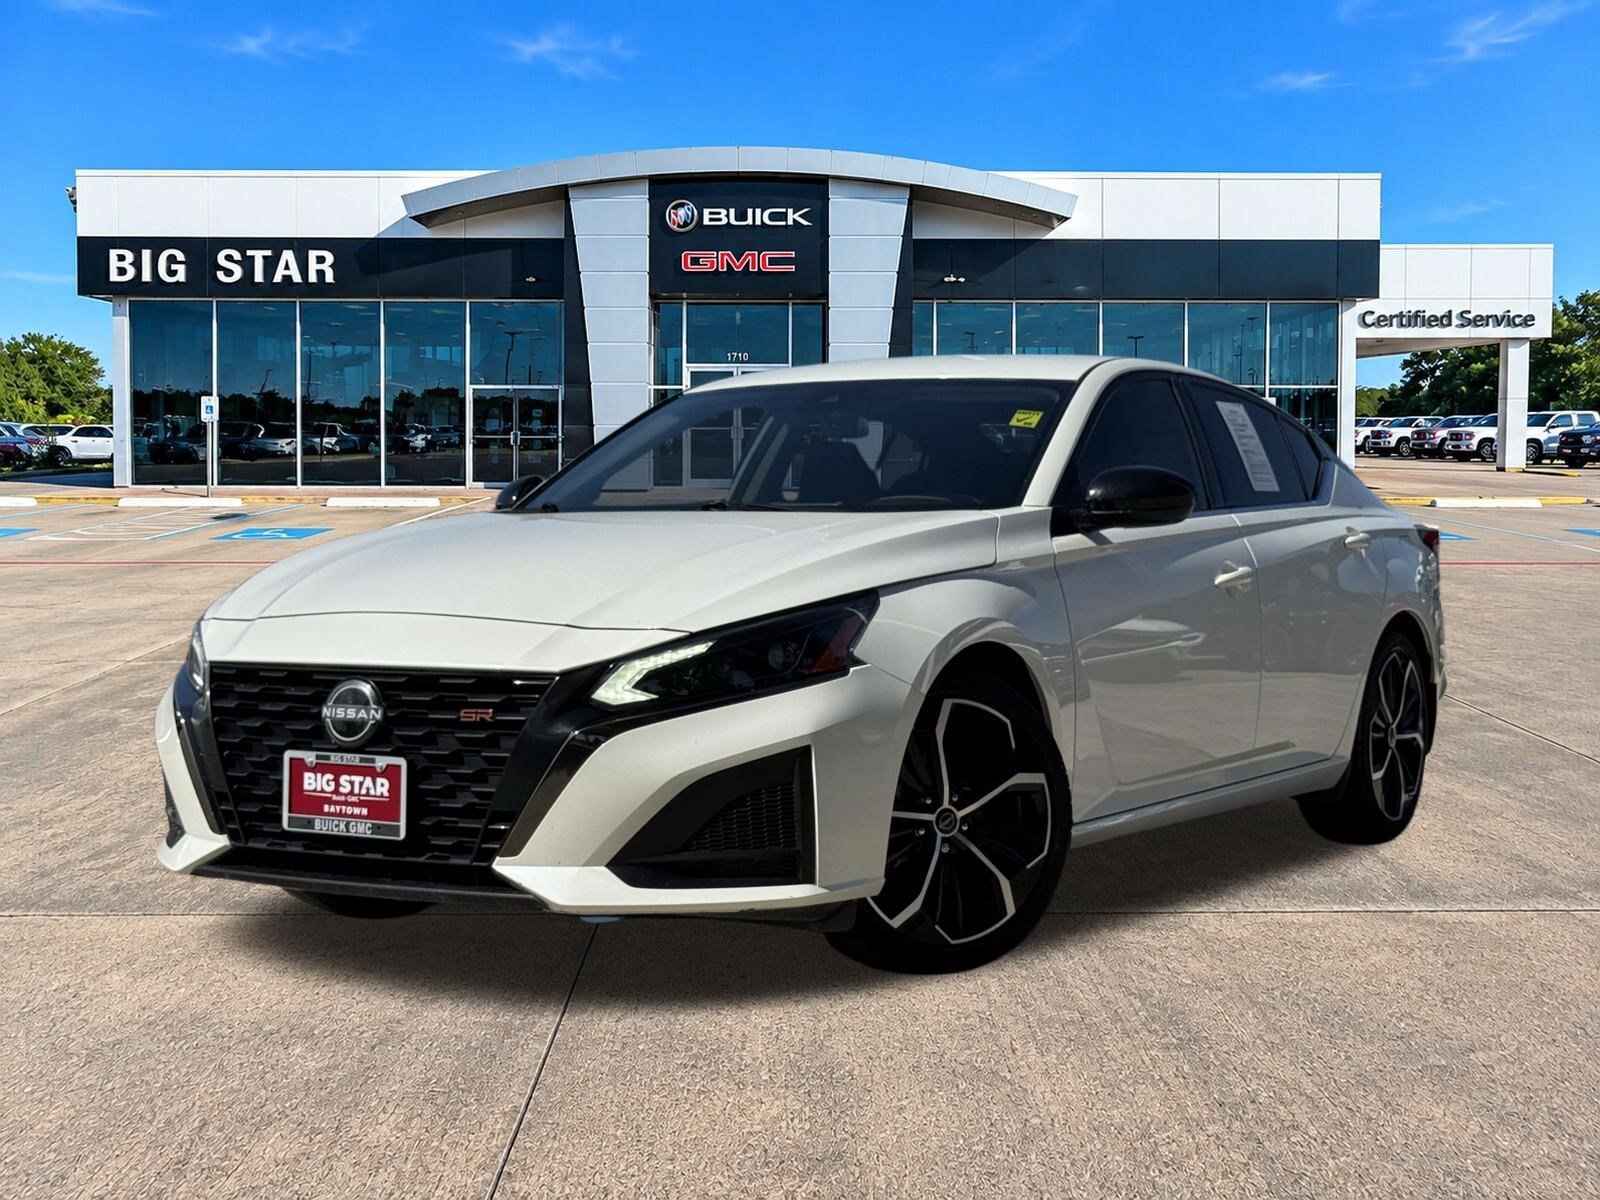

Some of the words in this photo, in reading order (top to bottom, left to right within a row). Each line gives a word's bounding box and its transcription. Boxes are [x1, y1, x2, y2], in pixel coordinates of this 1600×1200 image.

[702, 208, 813, 226] BUICK
[108, 248, 186, 283] BIG
[215, 248, 336, 284] STAR
[681, 251, 796, 272] GMC
[1360, 309, 1453, 328] Certified
[1456, 309, 1536, 328] Service
[727, 352, 749, 362] 1710
[321, 706, 382, 720] NISSAN
[459, 708, 493, 722] SR
[303, 771, 336, 793] BIG
[339, 774, 390, 797] STAR
[323, 804, 368, 816] BAYTOWN
[314, 819, 347, 833] BUICK
[349, 822, 373, 834] GMC
